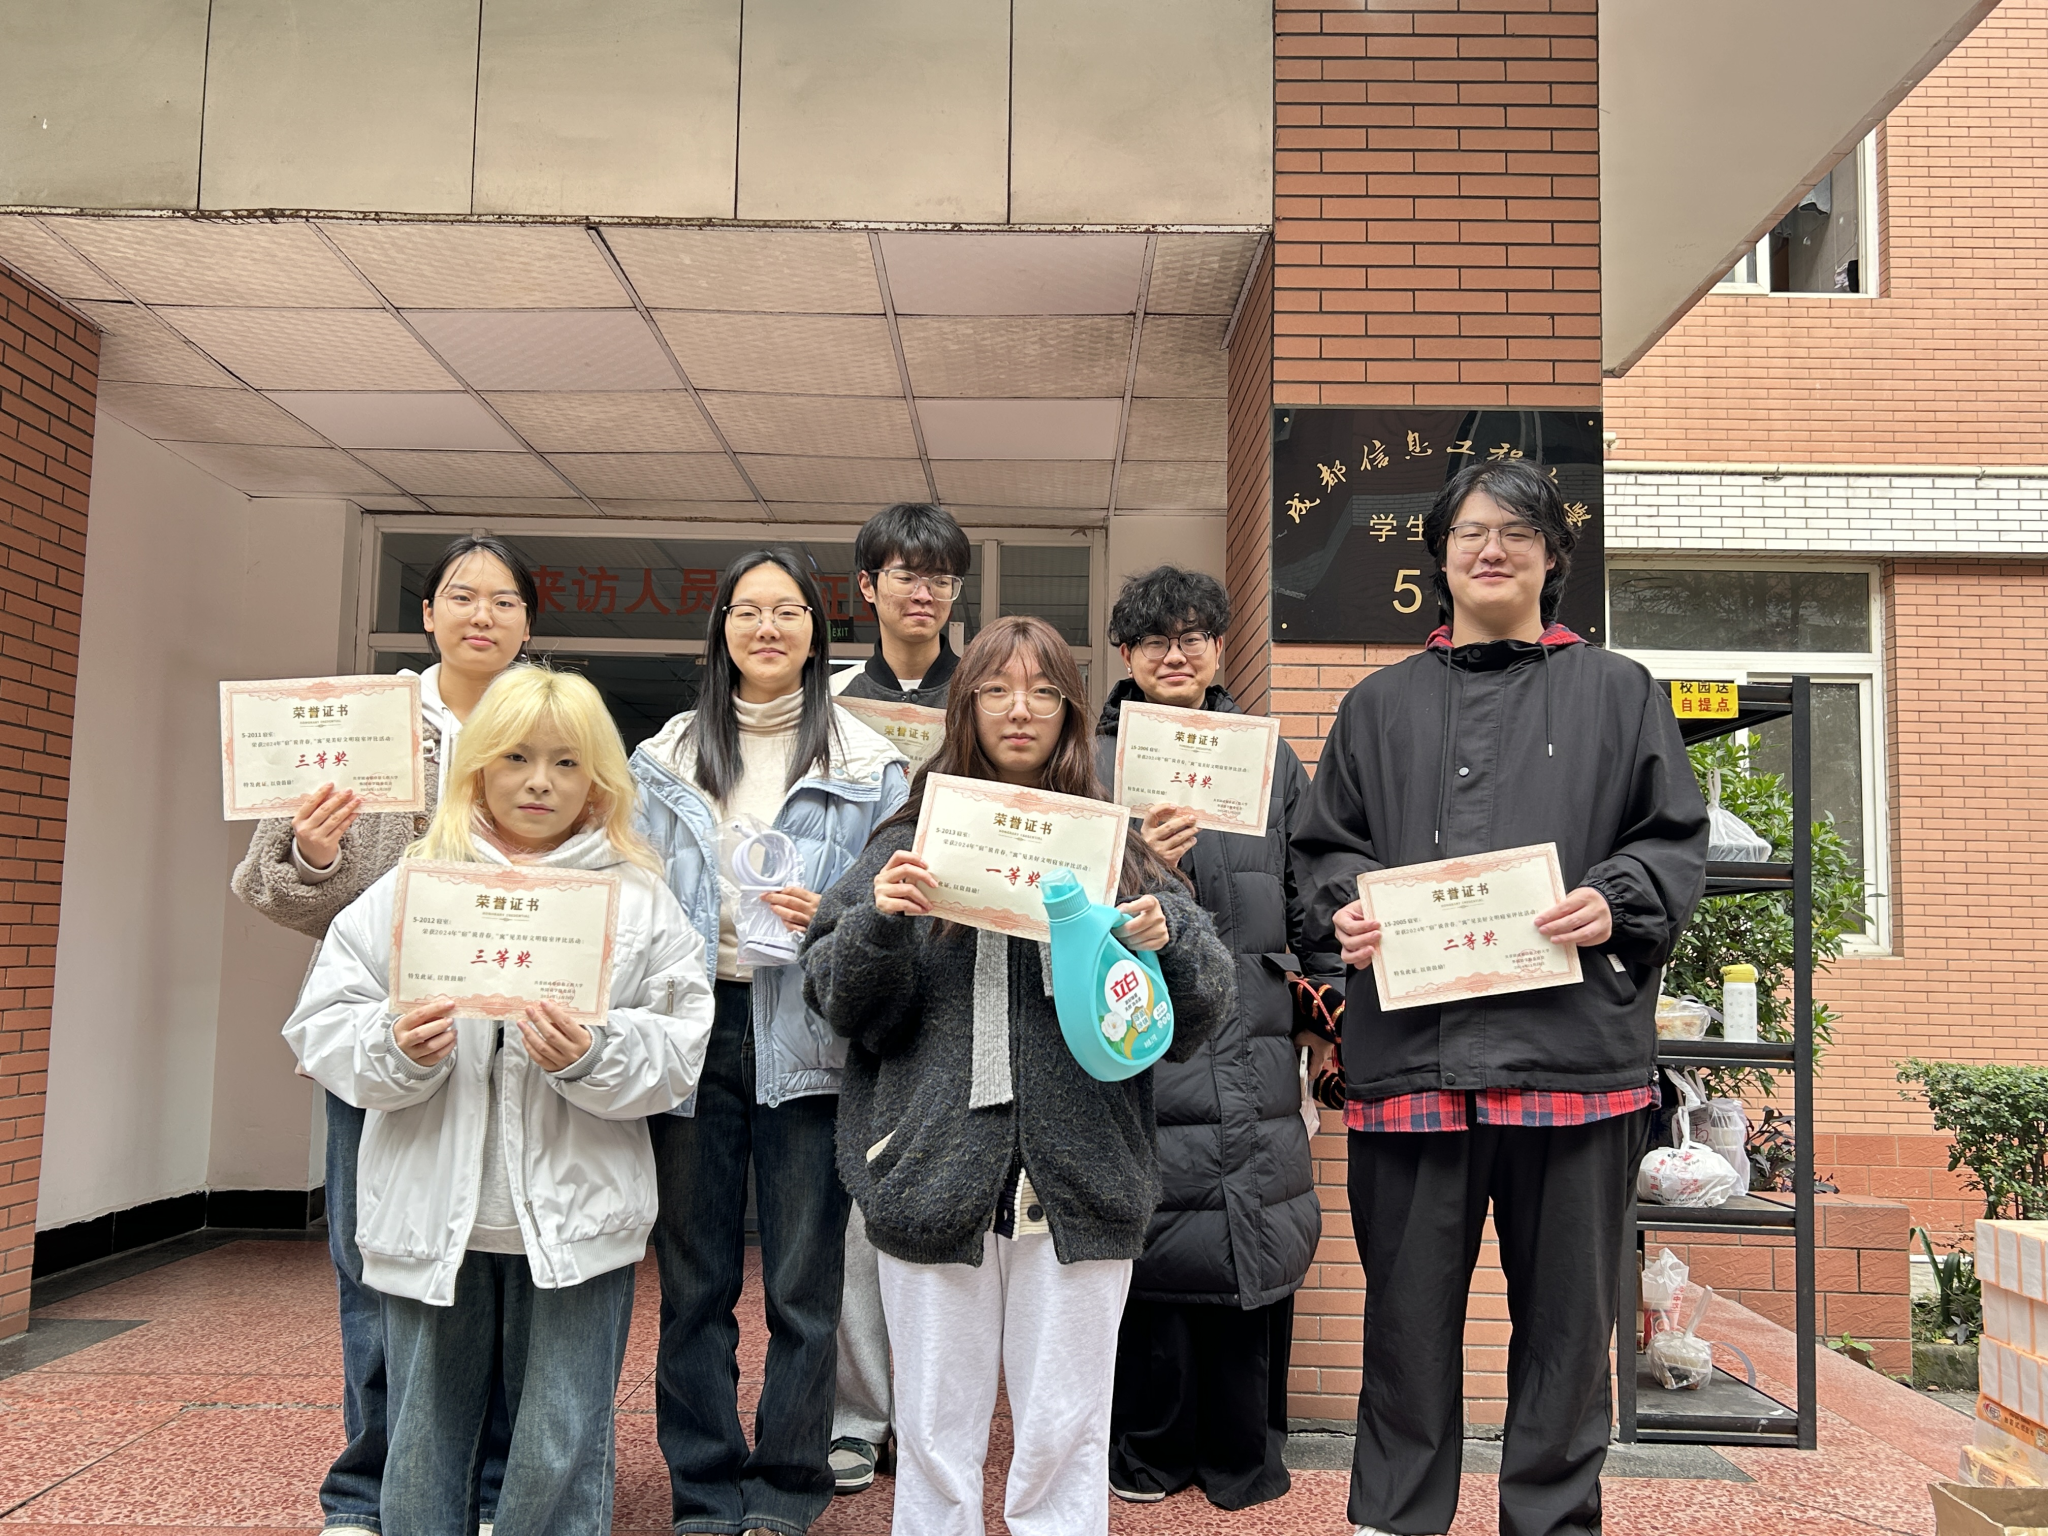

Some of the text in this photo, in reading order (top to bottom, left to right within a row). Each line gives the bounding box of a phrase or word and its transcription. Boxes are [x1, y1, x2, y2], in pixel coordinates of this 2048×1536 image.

[530, 565, 718, 616] 来访人员
[1392, 569, 1422, 614] 5
[832, 627, 849, 637] EXIT
[292, 704, 349, 719] 荣誉证书
[1682, 697, 1730, 712] 自提点
[884, 725, 929, 741] 荣誉证书
[1174, 731, 1219, 747] 荣誉证书
[295, 751, 349, 769] 三等奖
[1170, 771, 1213, 789] 三等奖
[936, 827, 956, 835] 5-2013
[993, 812, 1053, 835] 荣誉证书
[986, 866, 1041, 889] 一等奖
[937, 881, 980, 894] 此证，以资鼓励！
[1431, 882, 1489, 903] 荣誉证书
[475, 895, 539, 912] 荣誉证书
[1443, 930, 1499, 951] 二等奖
[470, 948, 533, 969] 三等奖
[1110, 970, 1139, 1003] 立白
